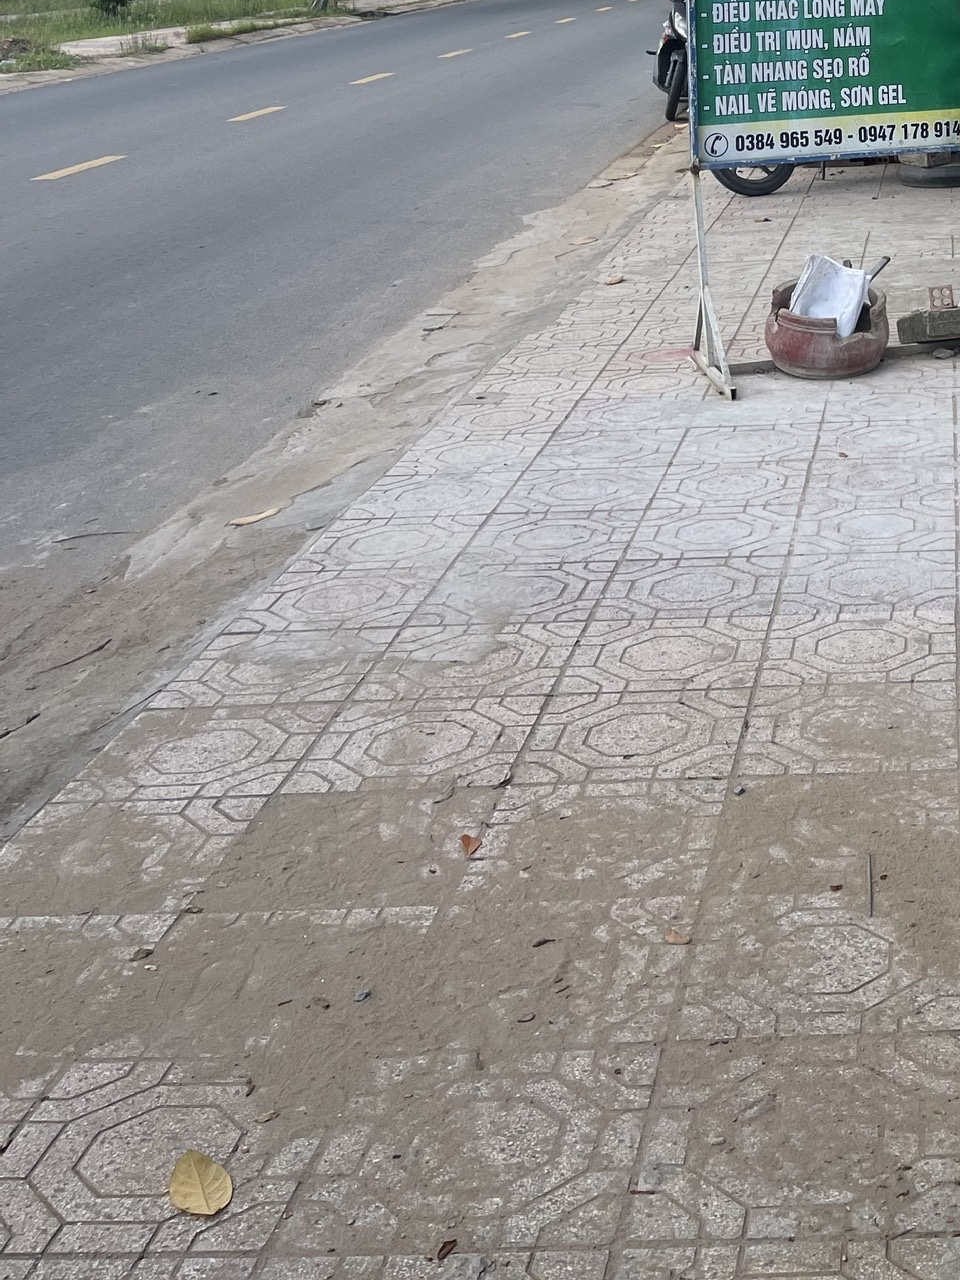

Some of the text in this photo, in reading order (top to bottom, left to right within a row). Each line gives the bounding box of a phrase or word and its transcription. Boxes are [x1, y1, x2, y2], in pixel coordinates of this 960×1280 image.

[712, 23, 871, 55] ĐIỀU TRỊ MỤN, NÁM
[713, 48, 871, 86] TÀN NHANG SẸO RỔ
[714, 84, 907, 117] NAIL VẼ MÓNG, SƠN GEL
[735, 133, 775, 152] 0384
[779, 130, 809, 149] 965
[814, 128, 843, 147] 549
[858, 124, 896, 143] 0947
[901, 122, 929, 140] 178
[934, 120, 960, 138] 914
